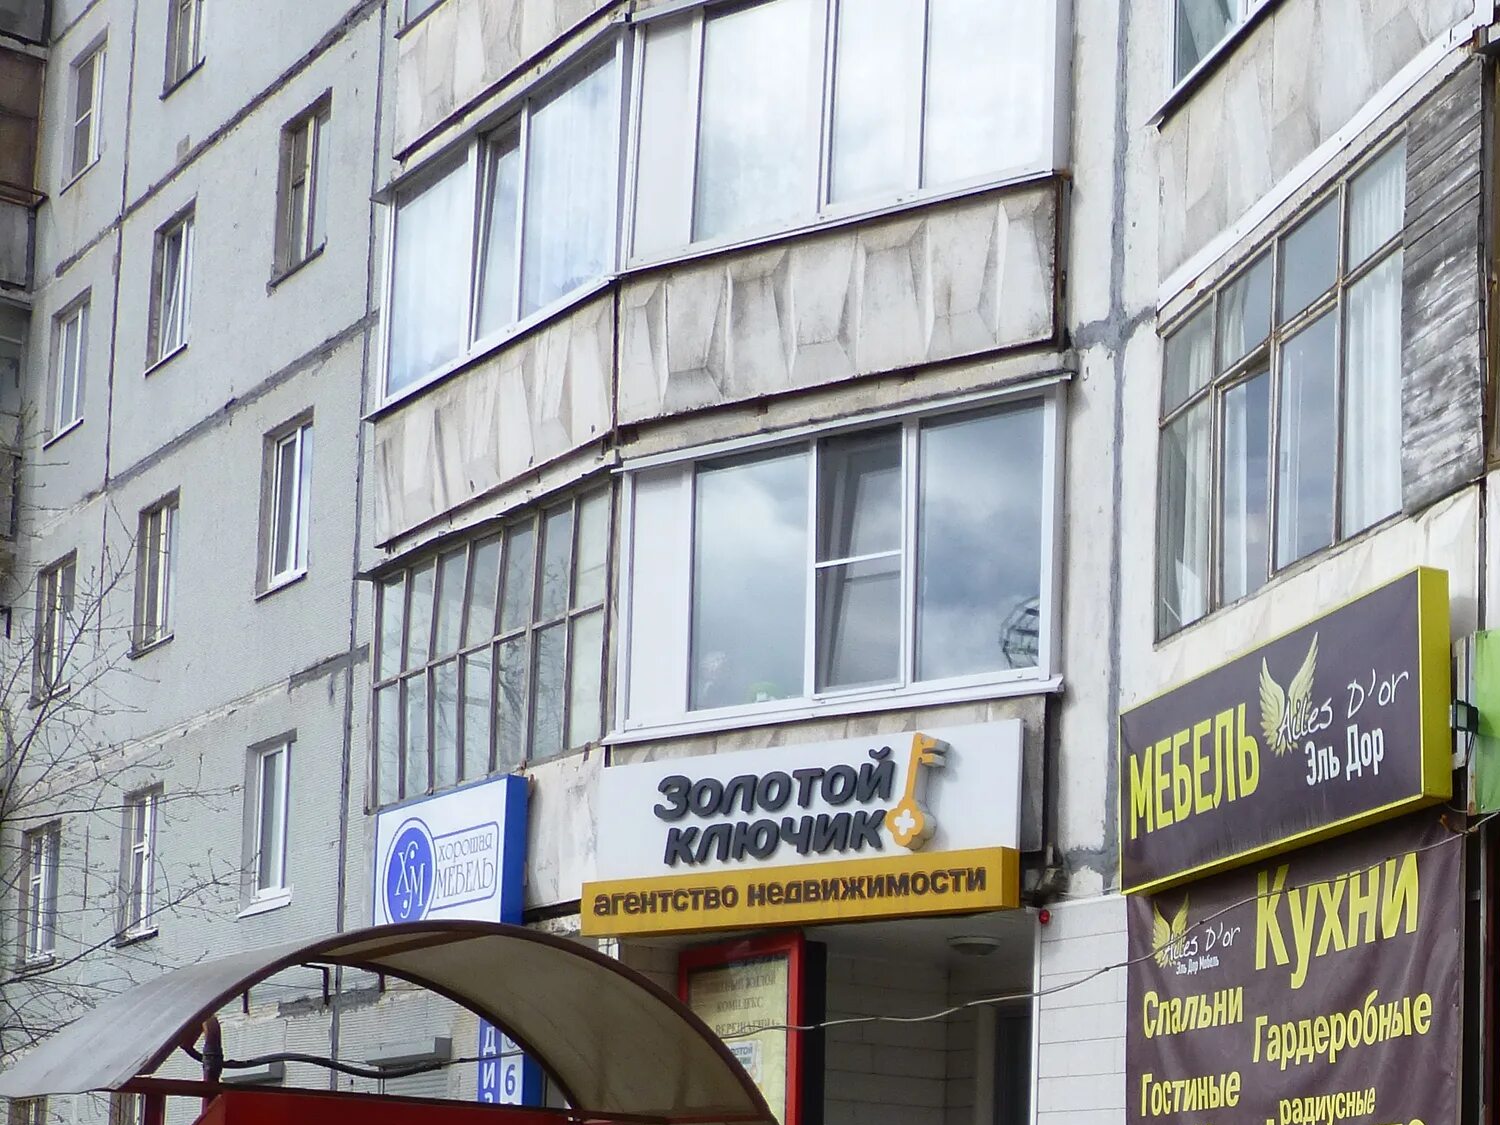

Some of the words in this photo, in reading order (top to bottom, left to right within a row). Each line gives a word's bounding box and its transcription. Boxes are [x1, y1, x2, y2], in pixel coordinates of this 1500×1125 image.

[1347, 668, 1410, 719] D'or
[1130, 702, 1260, 840] МЕБЕЛЬ
[1305, 740, 1340, 786] Эль
[1346, 723, 1385, 781] Дор
[436, 858, 494, 900] МЕБЕЛЬ
[594, 883, 740, 917] агентство
[746, 866, 988, 908] недвижимости
[1255, 850, 1420, 990] Кухни
[1142, 985, 1244, 1039] Спальни
[1252, 990, 1432, 1070] Гардеробные
[1140, 1069, 1241, 1117] Гостиные
